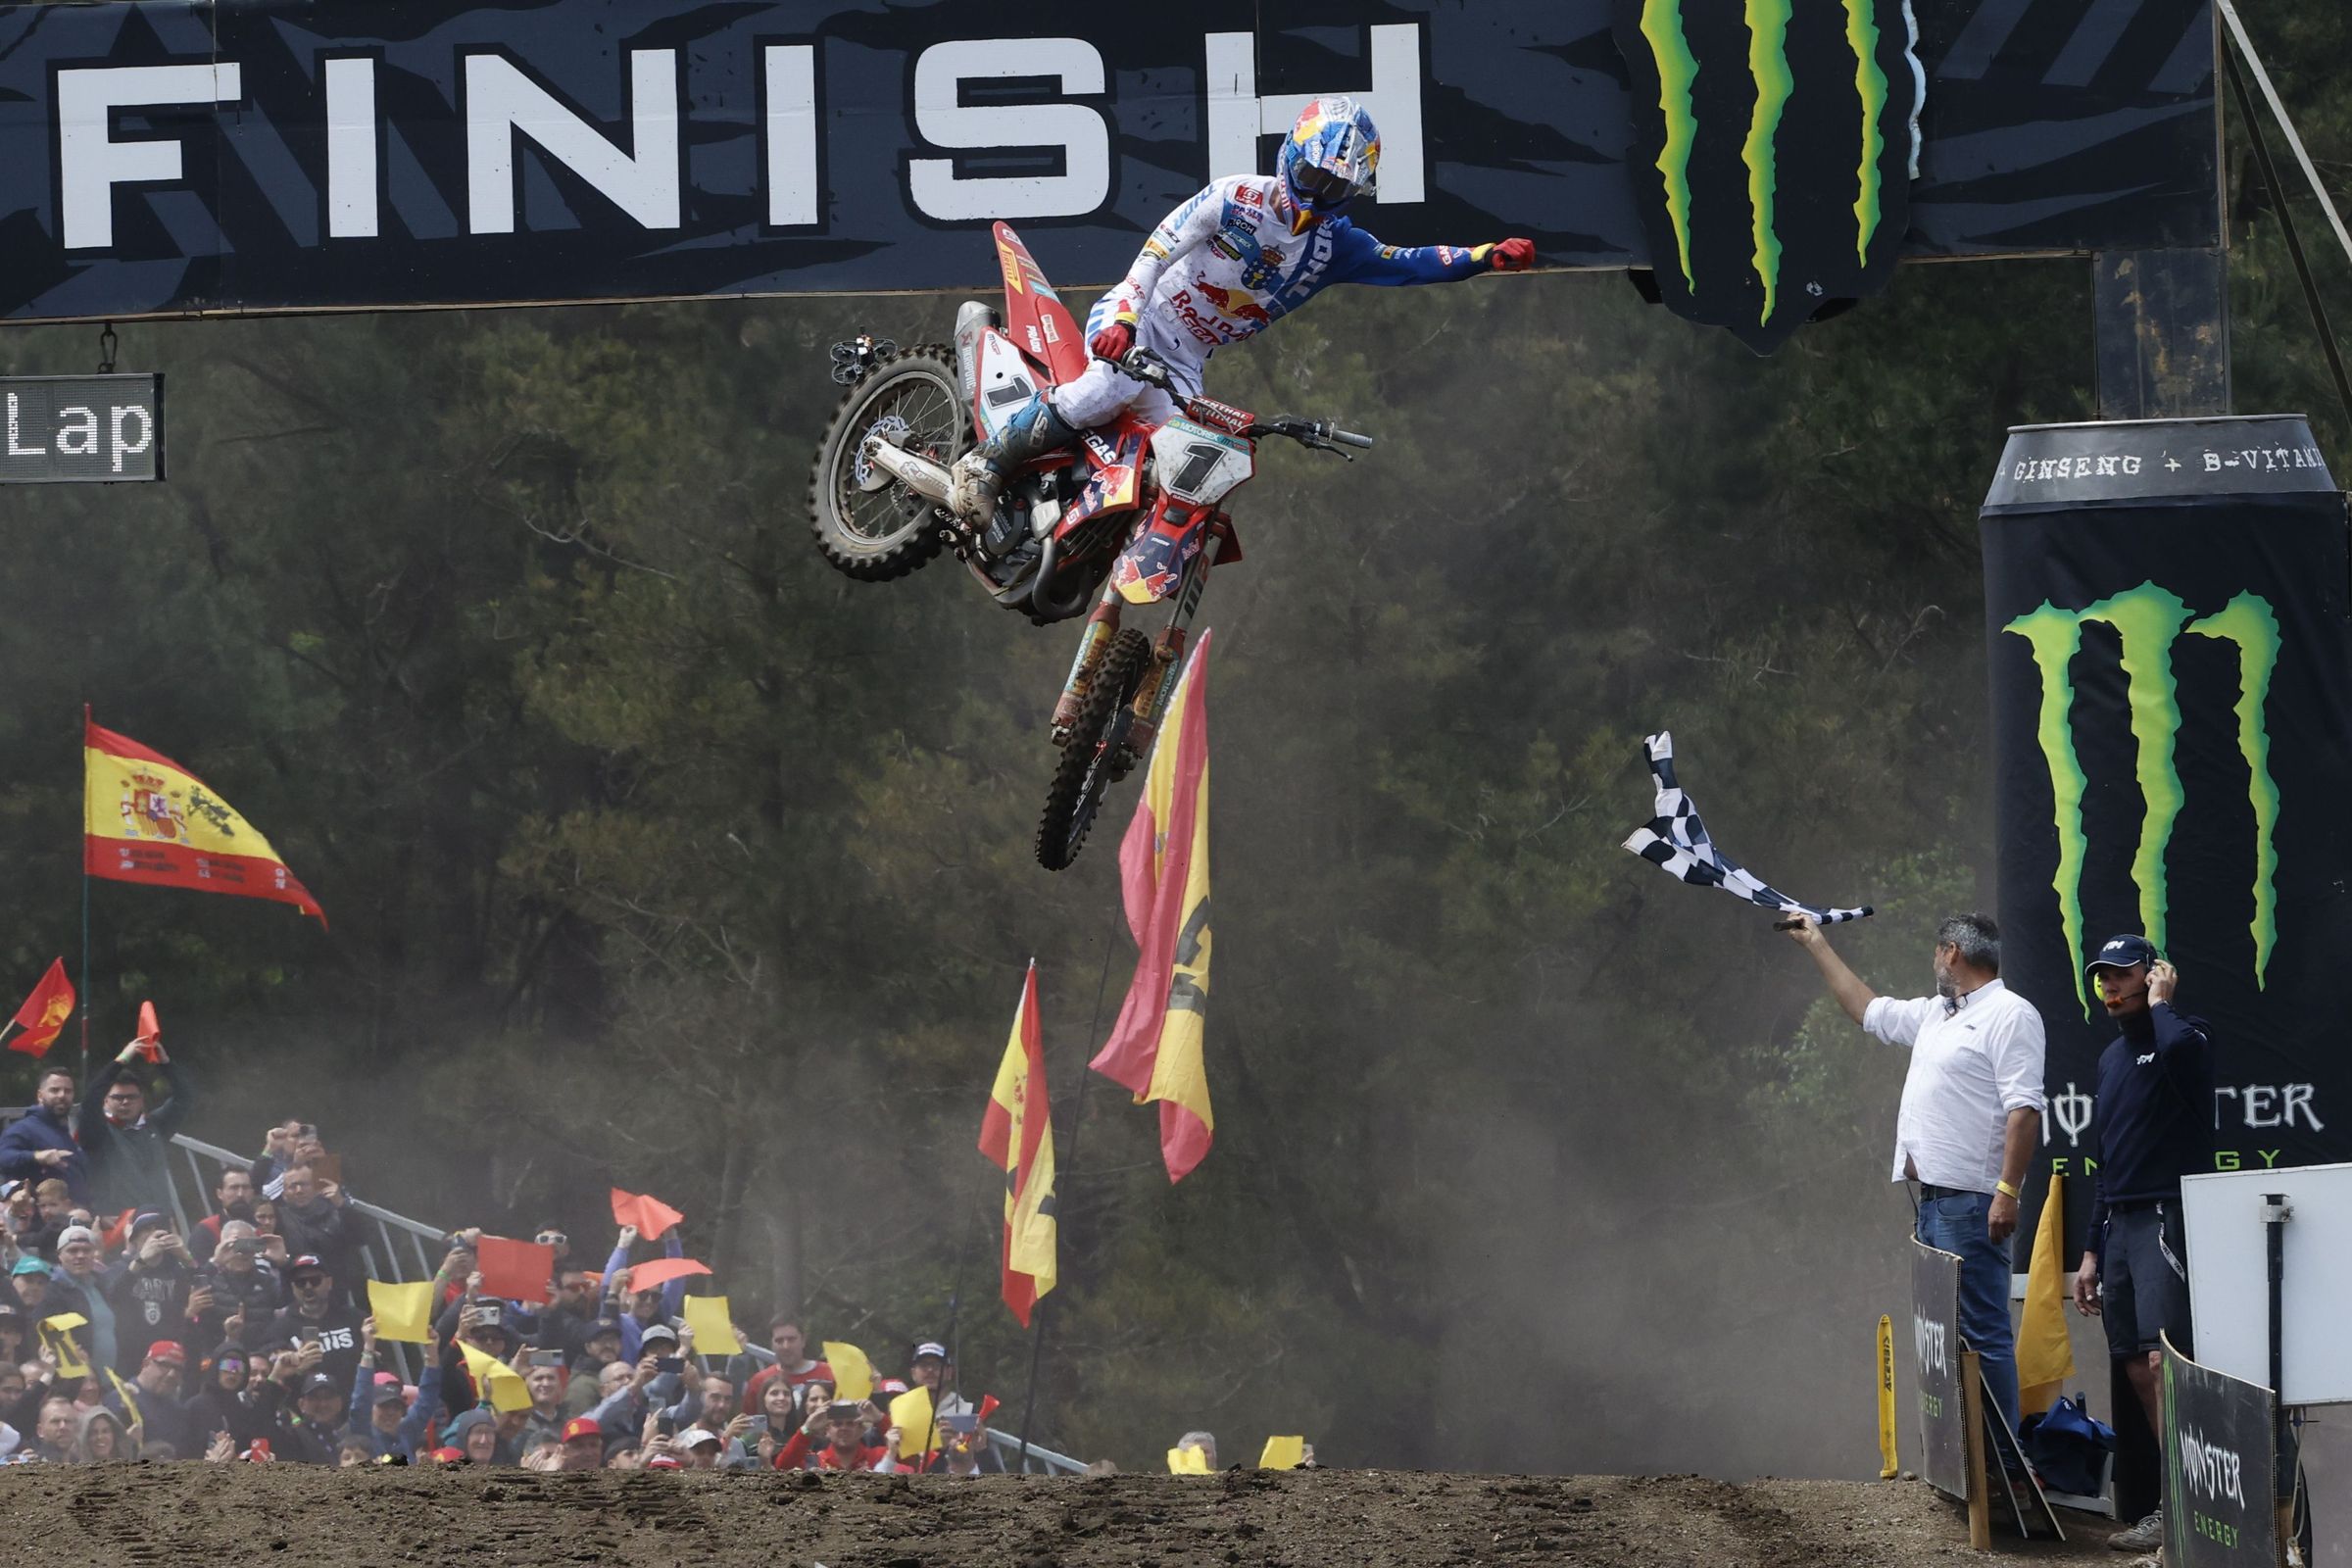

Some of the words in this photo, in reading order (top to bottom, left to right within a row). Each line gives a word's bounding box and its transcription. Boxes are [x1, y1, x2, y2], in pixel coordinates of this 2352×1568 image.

[57, 22, 1425, 250] FINISH
[1002, 249, 1018, 282] PIRELLI
[983, 373, 1036, 411] 1
[8, 392, 152, 472] Lap
[1180, 422, 1222, 443] MOTOREX
[1168, 441, 1228, 497] 1
[2014, 455, 2142, 483] GINSENG
[1155, 659, 1181, 708] MOTOREX
[1883, 1335, 1892, 1393] ACERBIS
[2179, 1423, 2246, 1512] MONSTER
[2193, 1509, 2239, 1550] ENERGY
